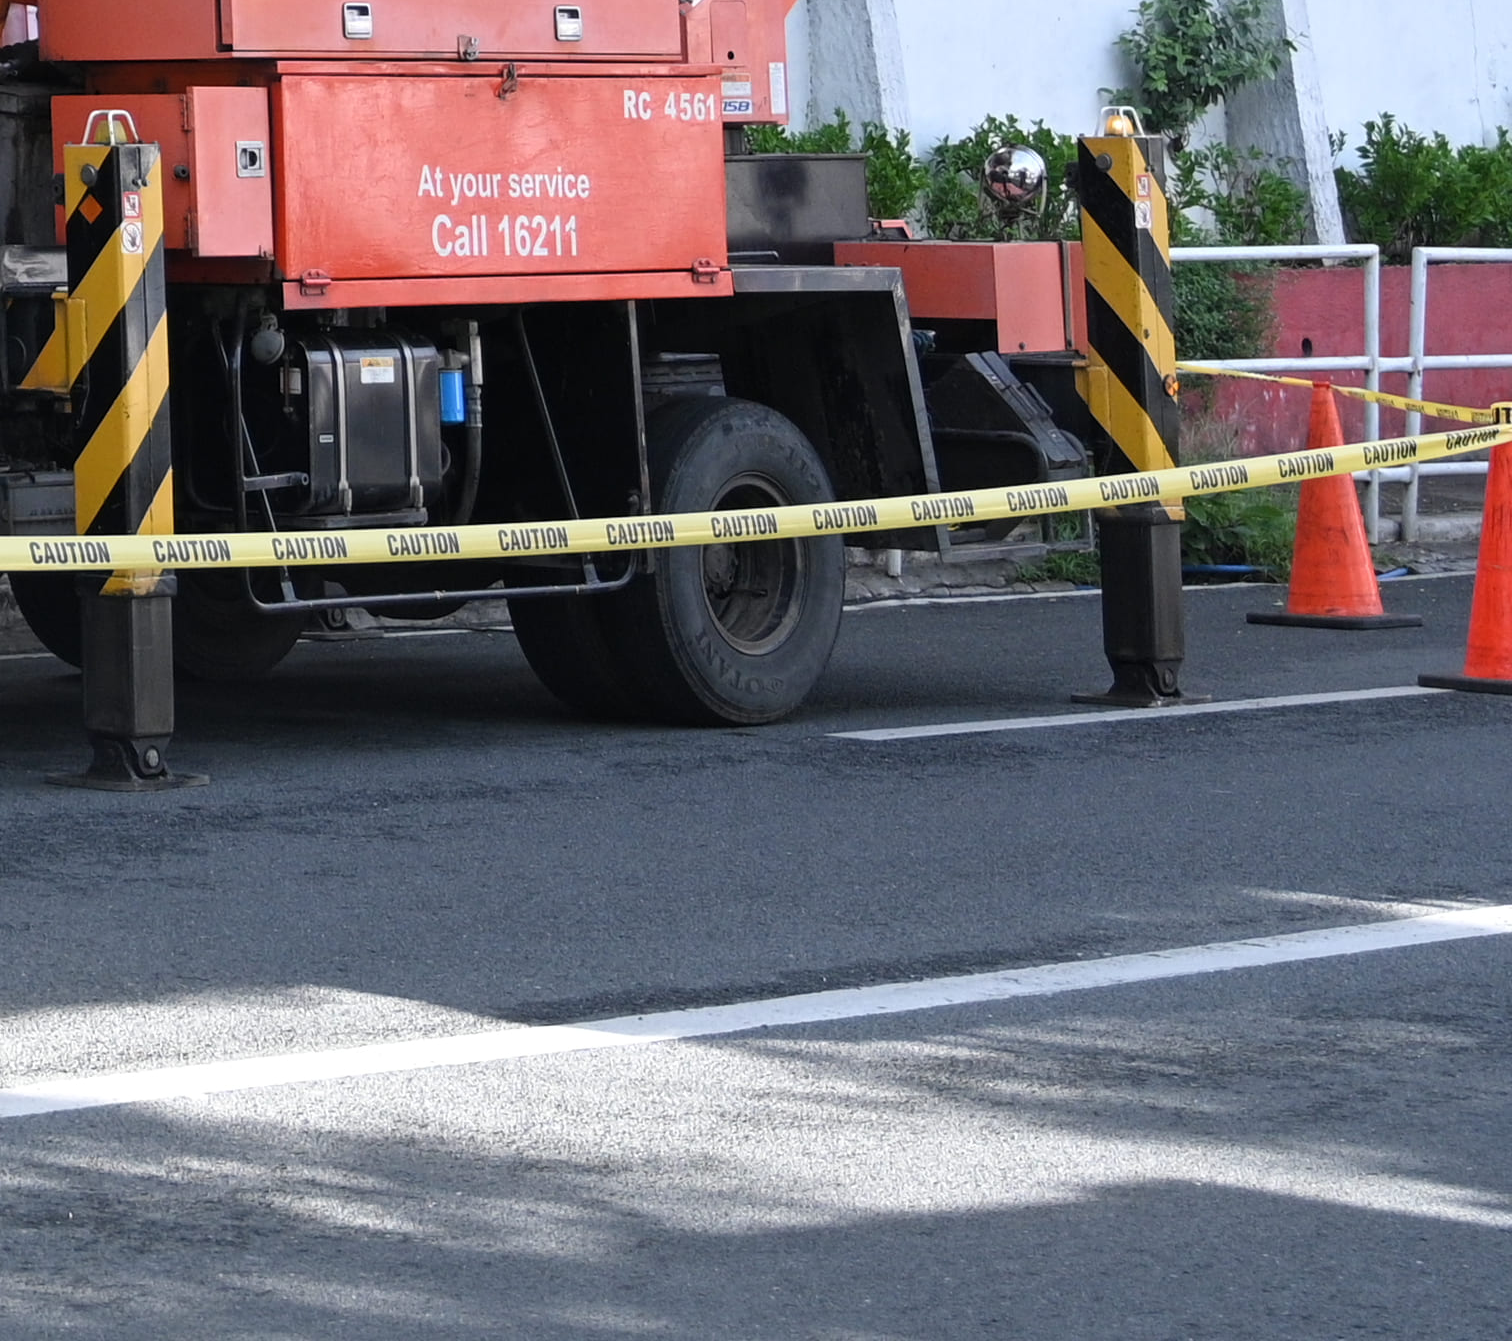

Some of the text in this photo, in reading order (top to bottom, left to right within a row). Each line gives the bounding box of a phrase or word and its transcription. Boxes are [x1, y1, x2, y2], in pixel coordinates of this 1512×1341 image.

[623, 89, 716, 121] RC 4561
[417, 165, 591, 206] At your service
[431, 214, 578, 257] Call 16211
[29, 541, 110, 565] CAUTION
[152, 539, 231, 564] CAUTION
[271, 536, 348, 561] CAUTION
[386, 531, 460, 556] CAUTION
[497, 527, 568, 552] CAUTION
[605, 520, 675, 546] CAUTION
[710, 513, 778, 539] CAUTION
[812, 505, 879, 530] CAUTION
[911, 495, 975, 520] CAUTION
[1005, 486, 1068, 511] CAUTION
[1099, 475, 1160, 502] CAUTION
[1189, 465, 1249, 491] CAUTION
[1277, 452, 1335, 478] CAUTION
[1362, 439, 1418, 465] CAUTION
[1445, 428, 1500, 451] CAUTION
